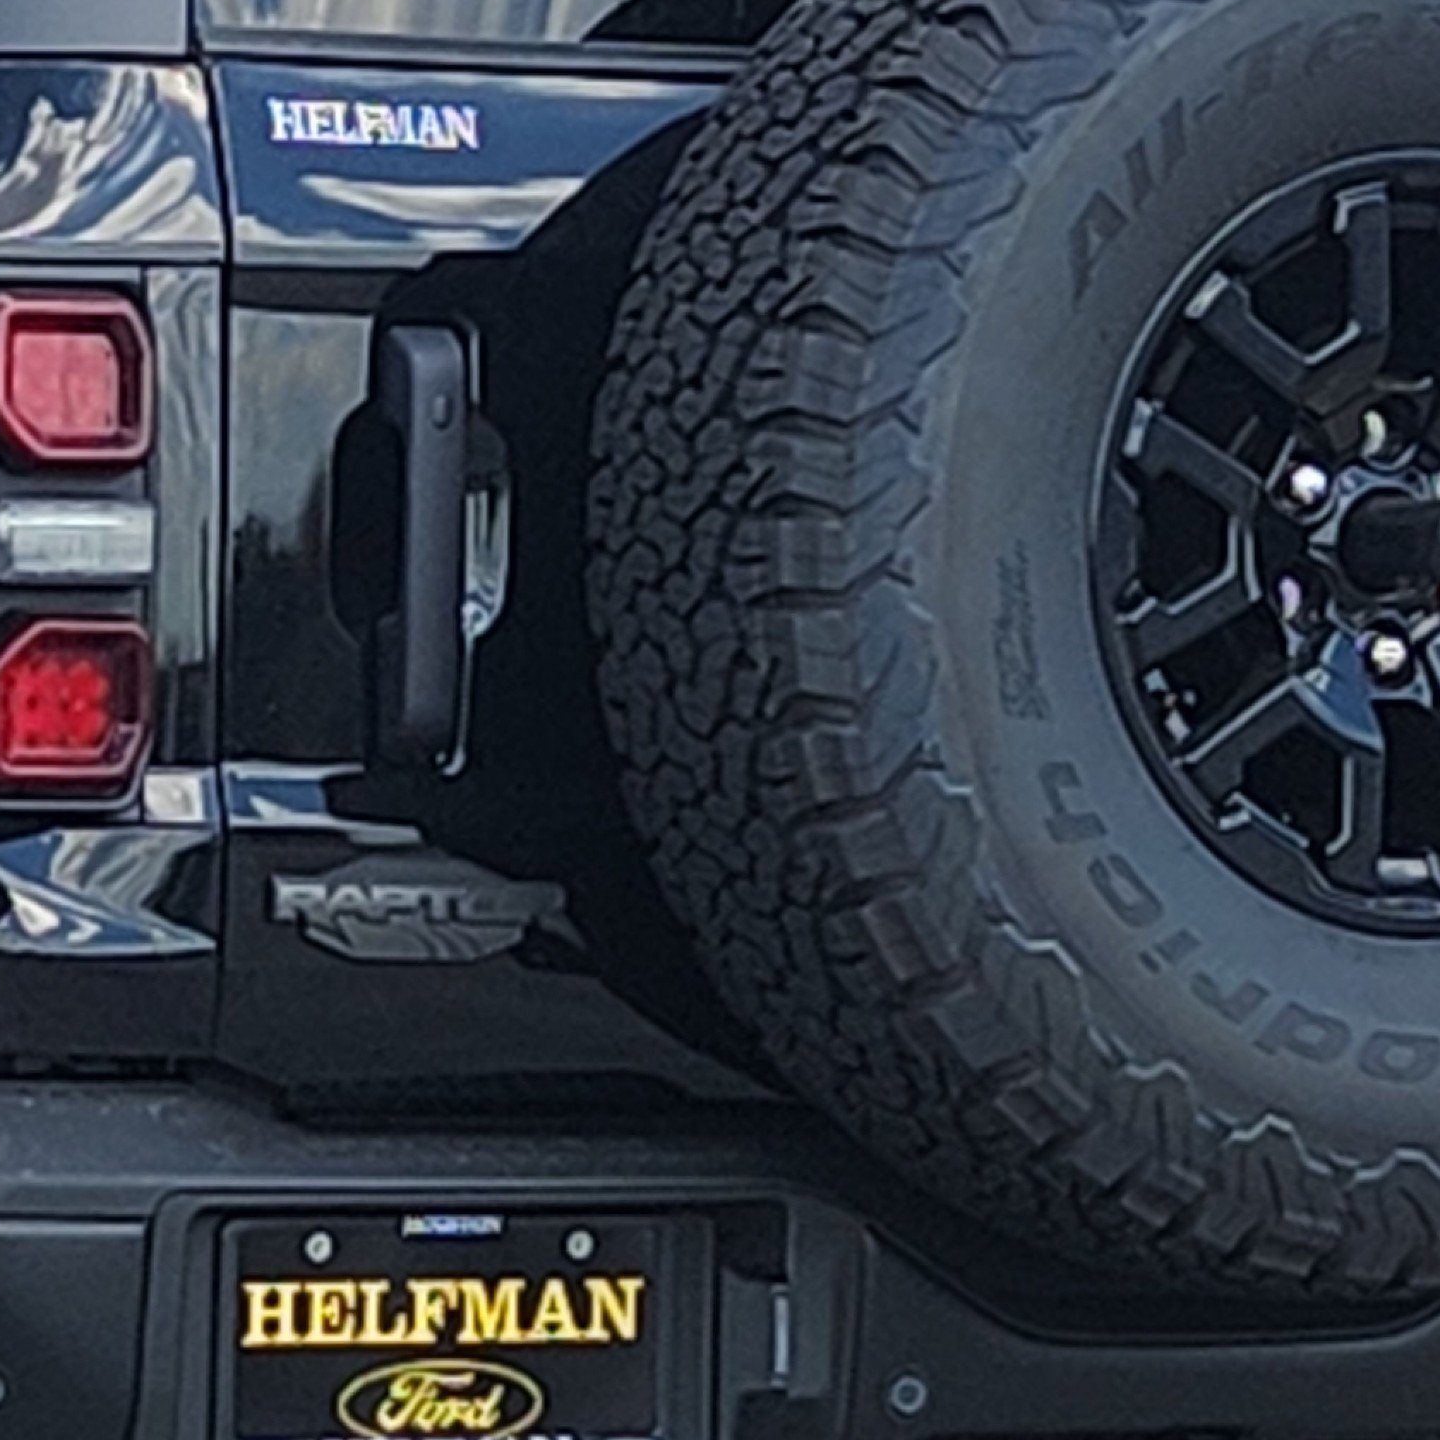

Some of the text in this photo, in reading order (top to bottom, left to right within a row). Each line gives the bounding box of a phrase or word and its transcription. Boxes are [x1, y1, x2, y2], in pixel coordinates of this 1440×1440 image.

[267, 96, 481, 150] HELFMAN
[239, 1276, 646, 1348] HELFMAN
[376, 1370, 502, 1432] Ford
